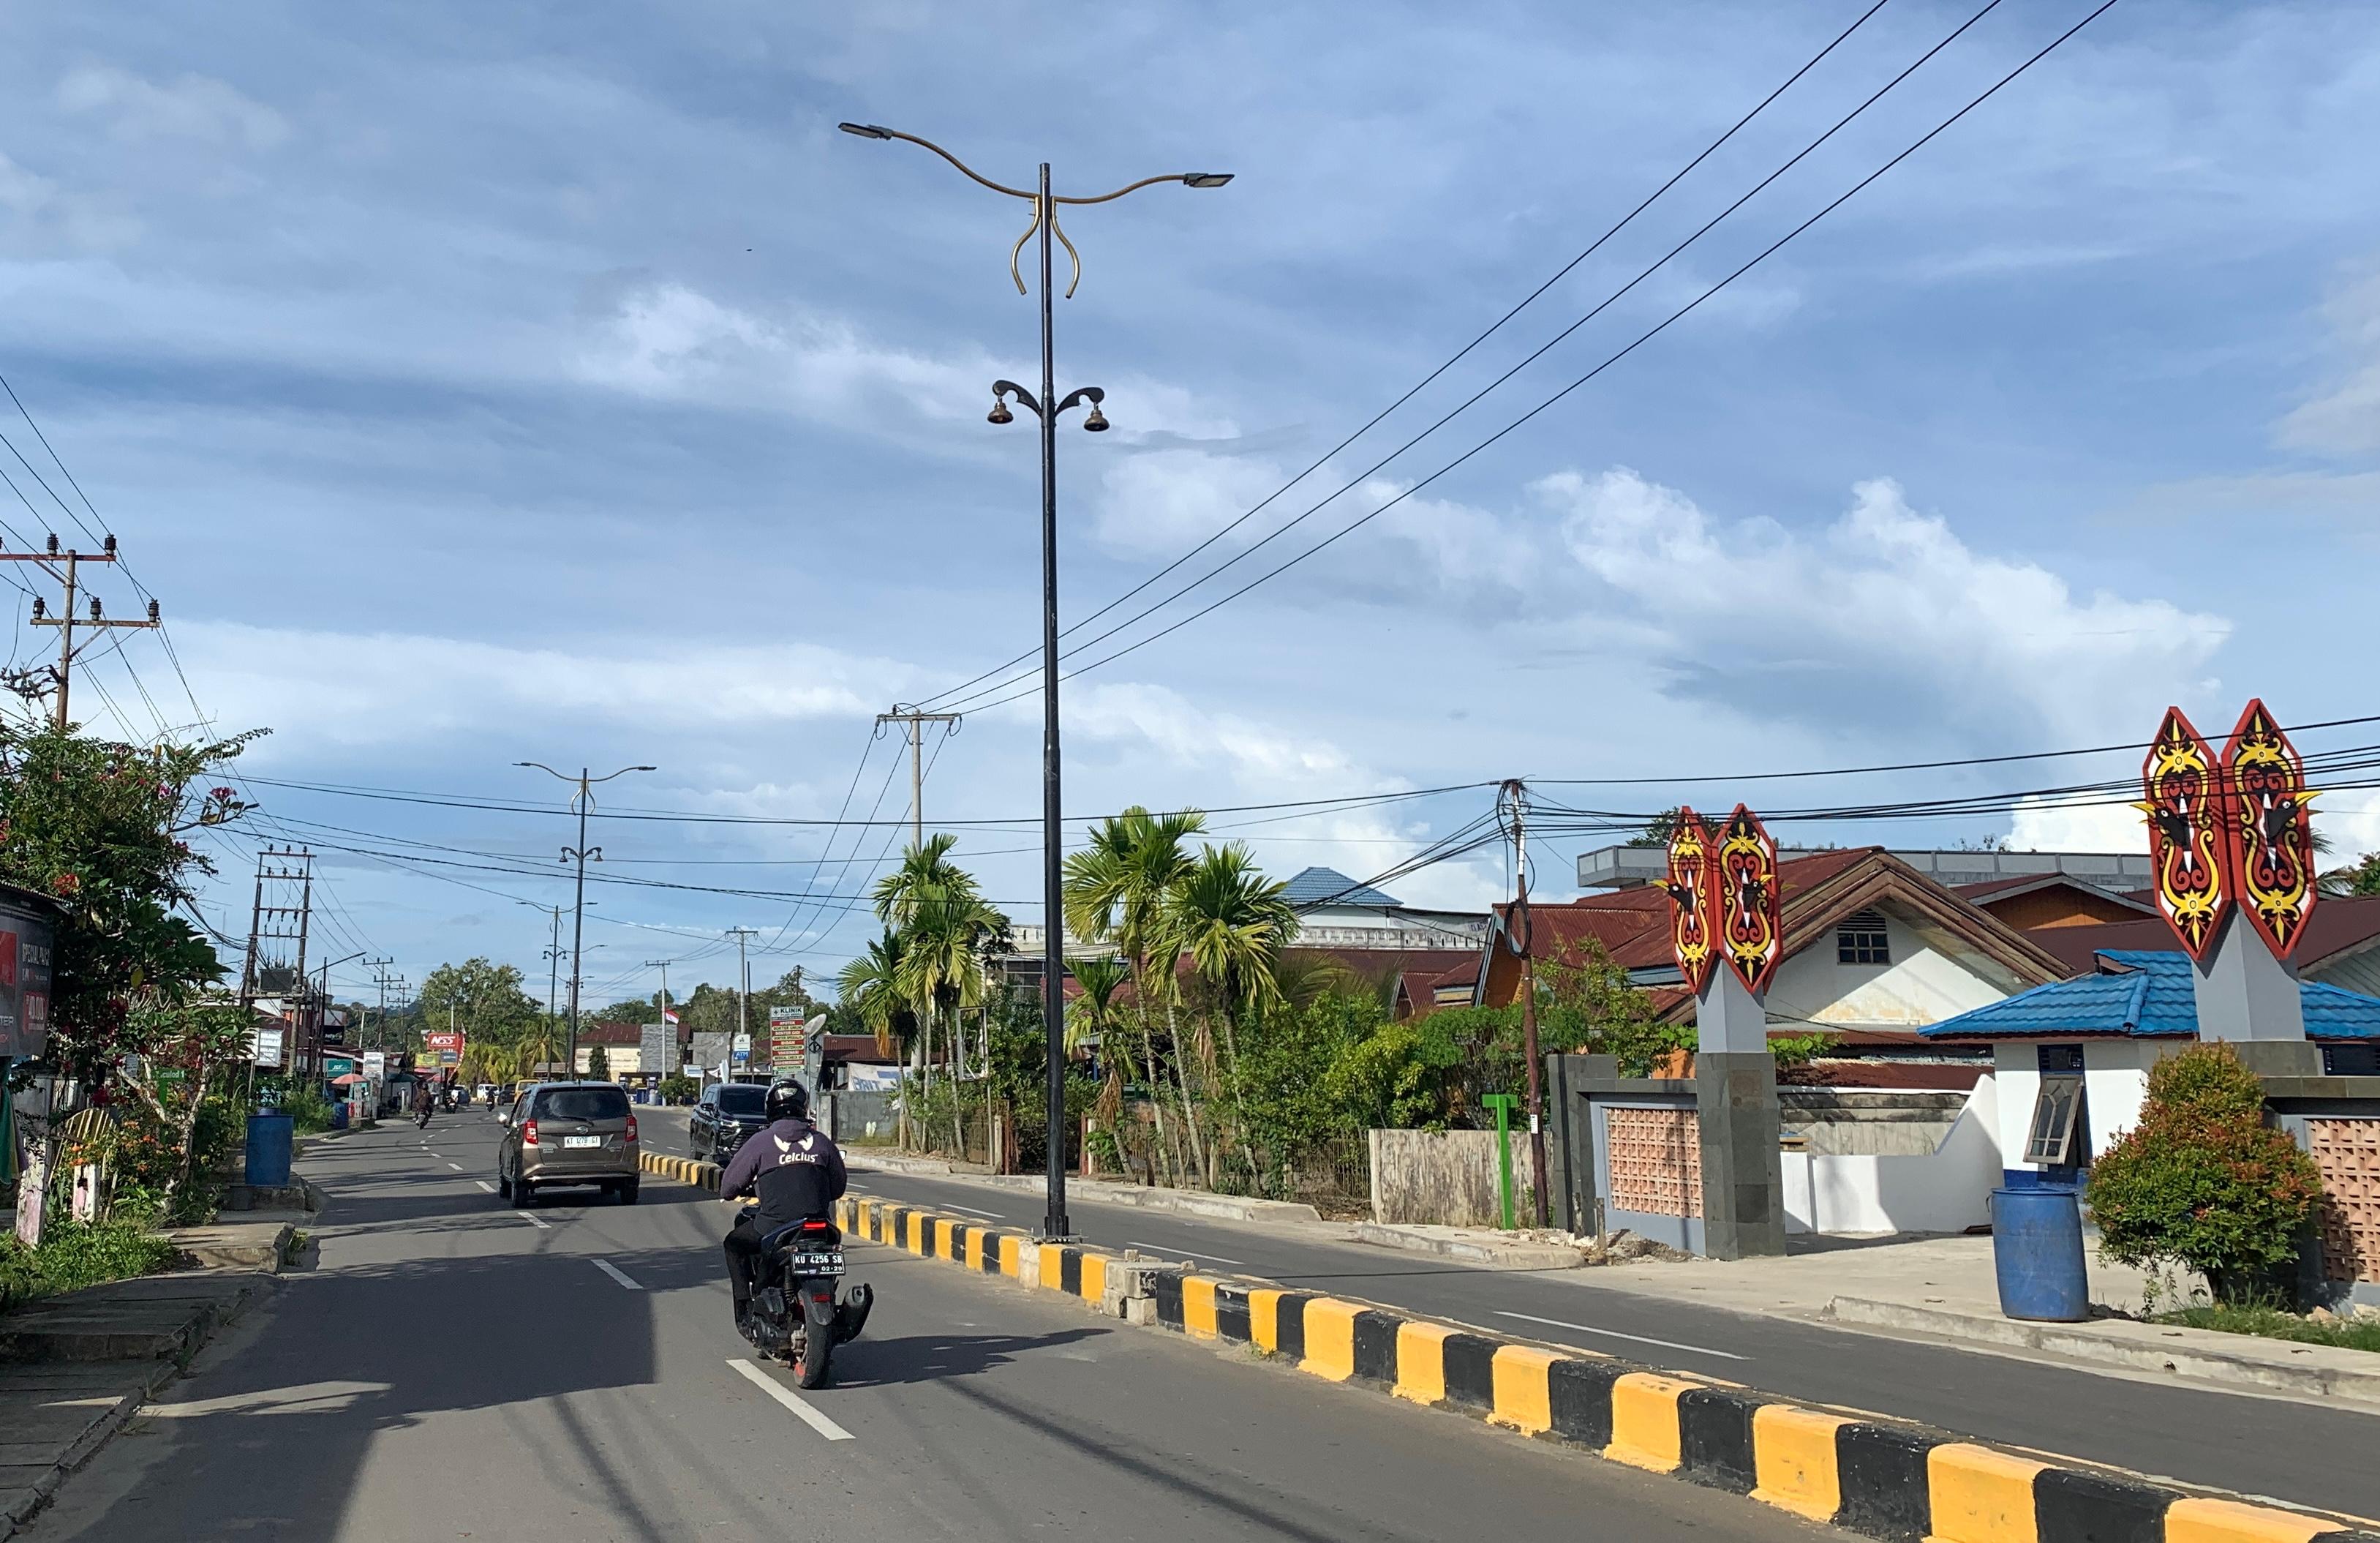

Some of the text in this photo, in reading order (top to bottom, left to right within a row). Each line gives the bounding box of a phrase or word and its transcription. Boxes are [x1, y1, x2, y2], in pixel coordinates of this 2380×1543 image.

[779, 1152, 816, 1165] Celcius
[794, 1255, 842, 1264] KU 4256 SB
